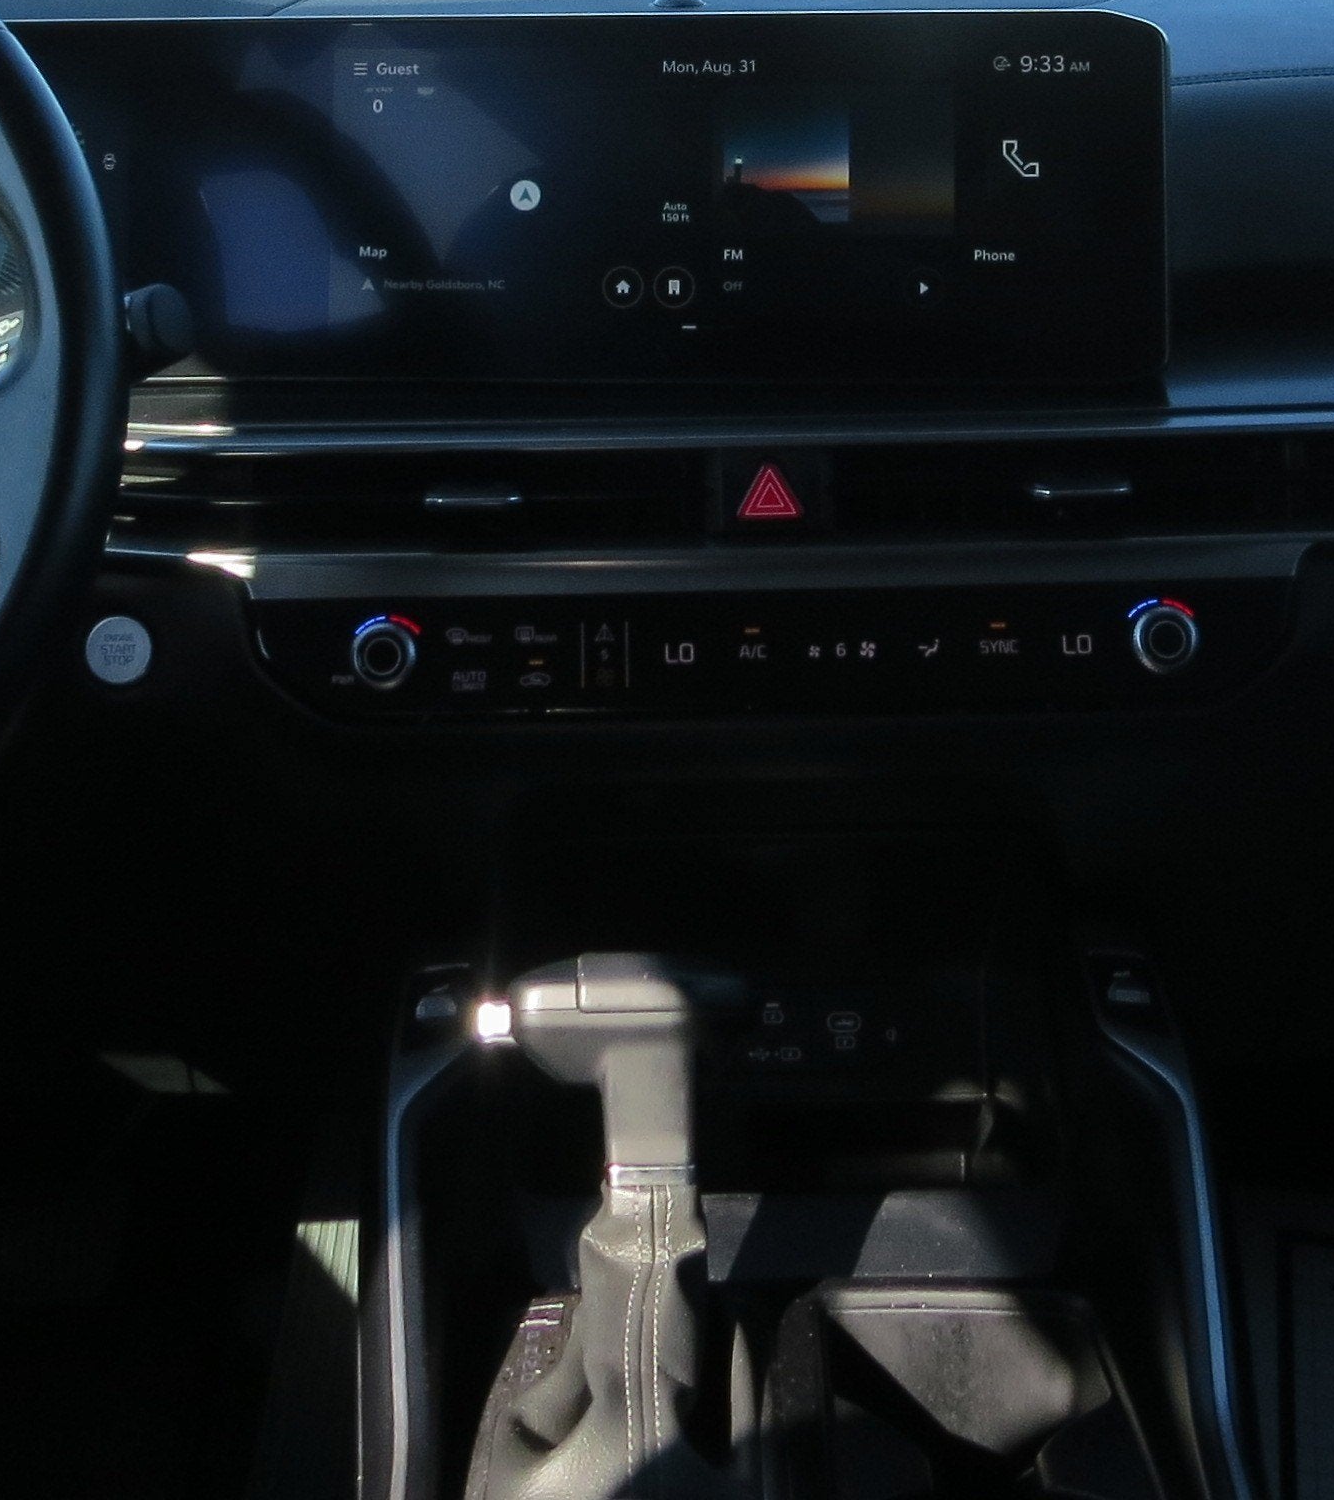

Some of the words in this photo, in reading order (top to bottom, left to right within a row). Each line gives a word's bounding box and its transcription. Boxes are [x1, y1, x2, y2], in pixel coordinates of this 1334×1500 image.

[376, 62, 420, 76] Guest
[662, 60, 698, 75] Mon,
[702, 60, 735, 76] Aug.
[739, 59, 756, 73] 31
[1020, 55, 1065, 73] 9:33
[1069, 61, 1091, 72] AM
[372, 99, 384, 114] 0
[663, 202, 688, 211] Auto
[681, 212, 690, 222] ft
[359, 246, 387, 260] Map
[723, 249, 744, 260] FM
[973, 250, 1016, 263] Phone
[383, 280, 424, 292] Nearby
[425, 280, 485, 292] Goldsboro,
[488, 280, 506, 290] NC
[723, 281, 744, 292] Off
[738, 643, 768, 659] A/C
[835, 642, 847, 658] 6
[979, 638, 1018, 655] SYNC
[1062, 633, 1093, 656] LO
[664, 642, 695, 664] LO
[452, 670, 487, 682] AUTO
